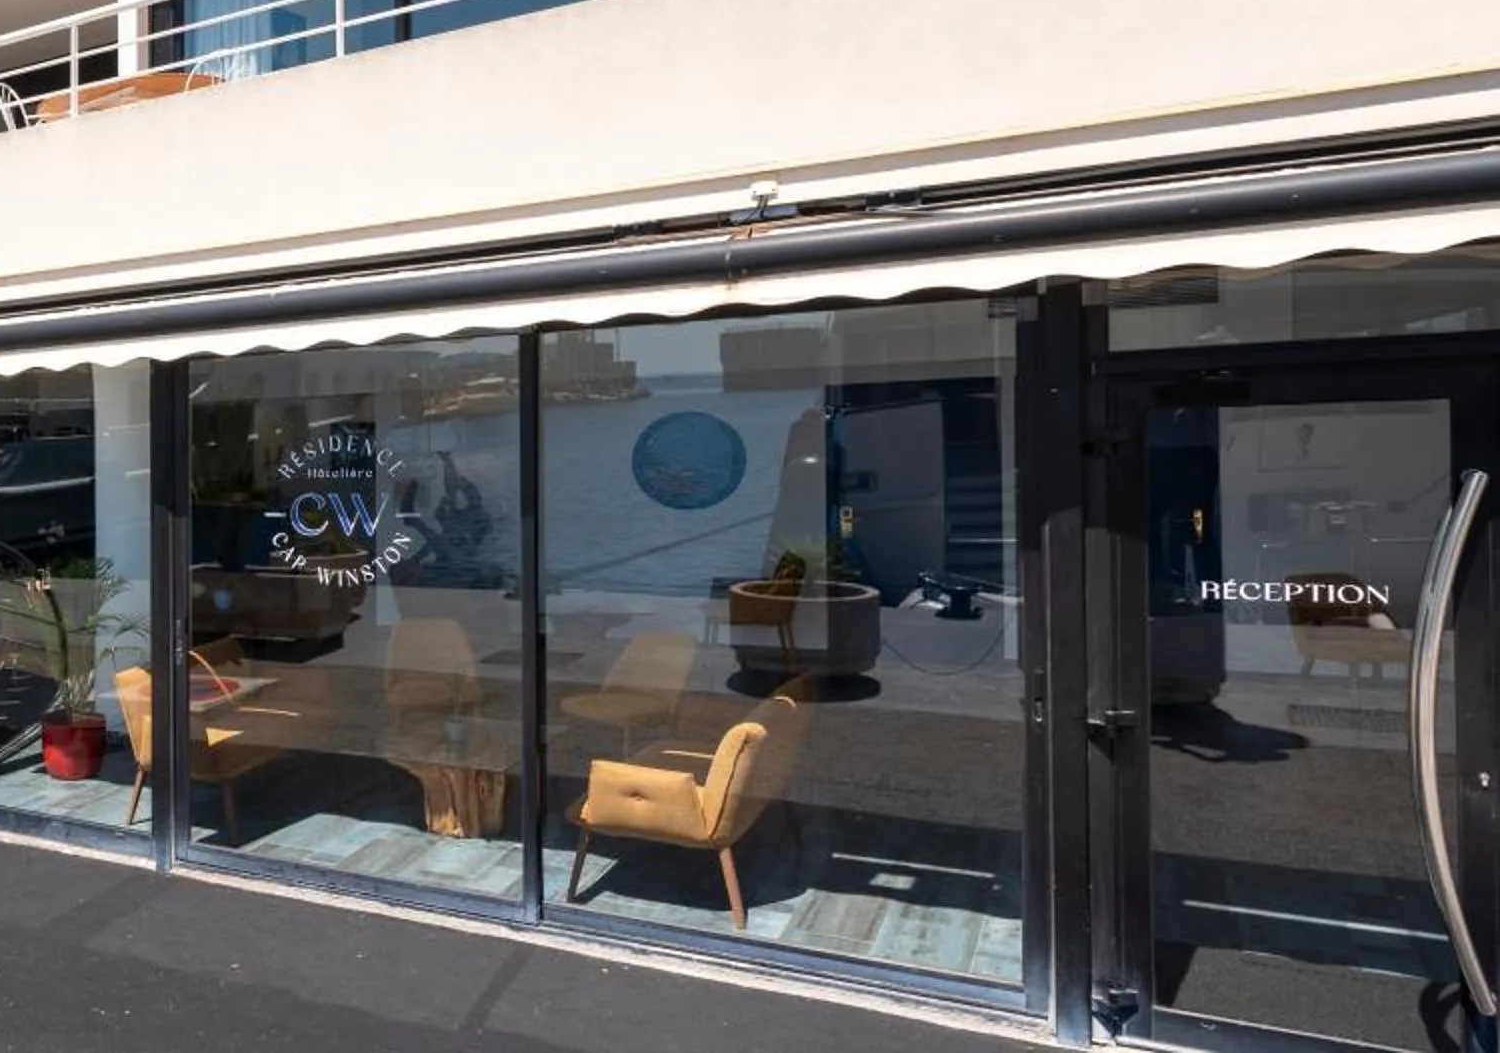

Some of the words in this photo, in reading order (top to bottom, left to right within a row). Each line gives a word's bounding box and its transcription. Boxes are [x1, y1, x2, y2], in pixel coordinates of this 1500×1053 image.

[290, 492, 390, 537] CW
[272, 532, 307, 568] CAP
[317, 532, 412, 587] WINSTON
[1201, 578, 1389, 604] RÉCEPTION
